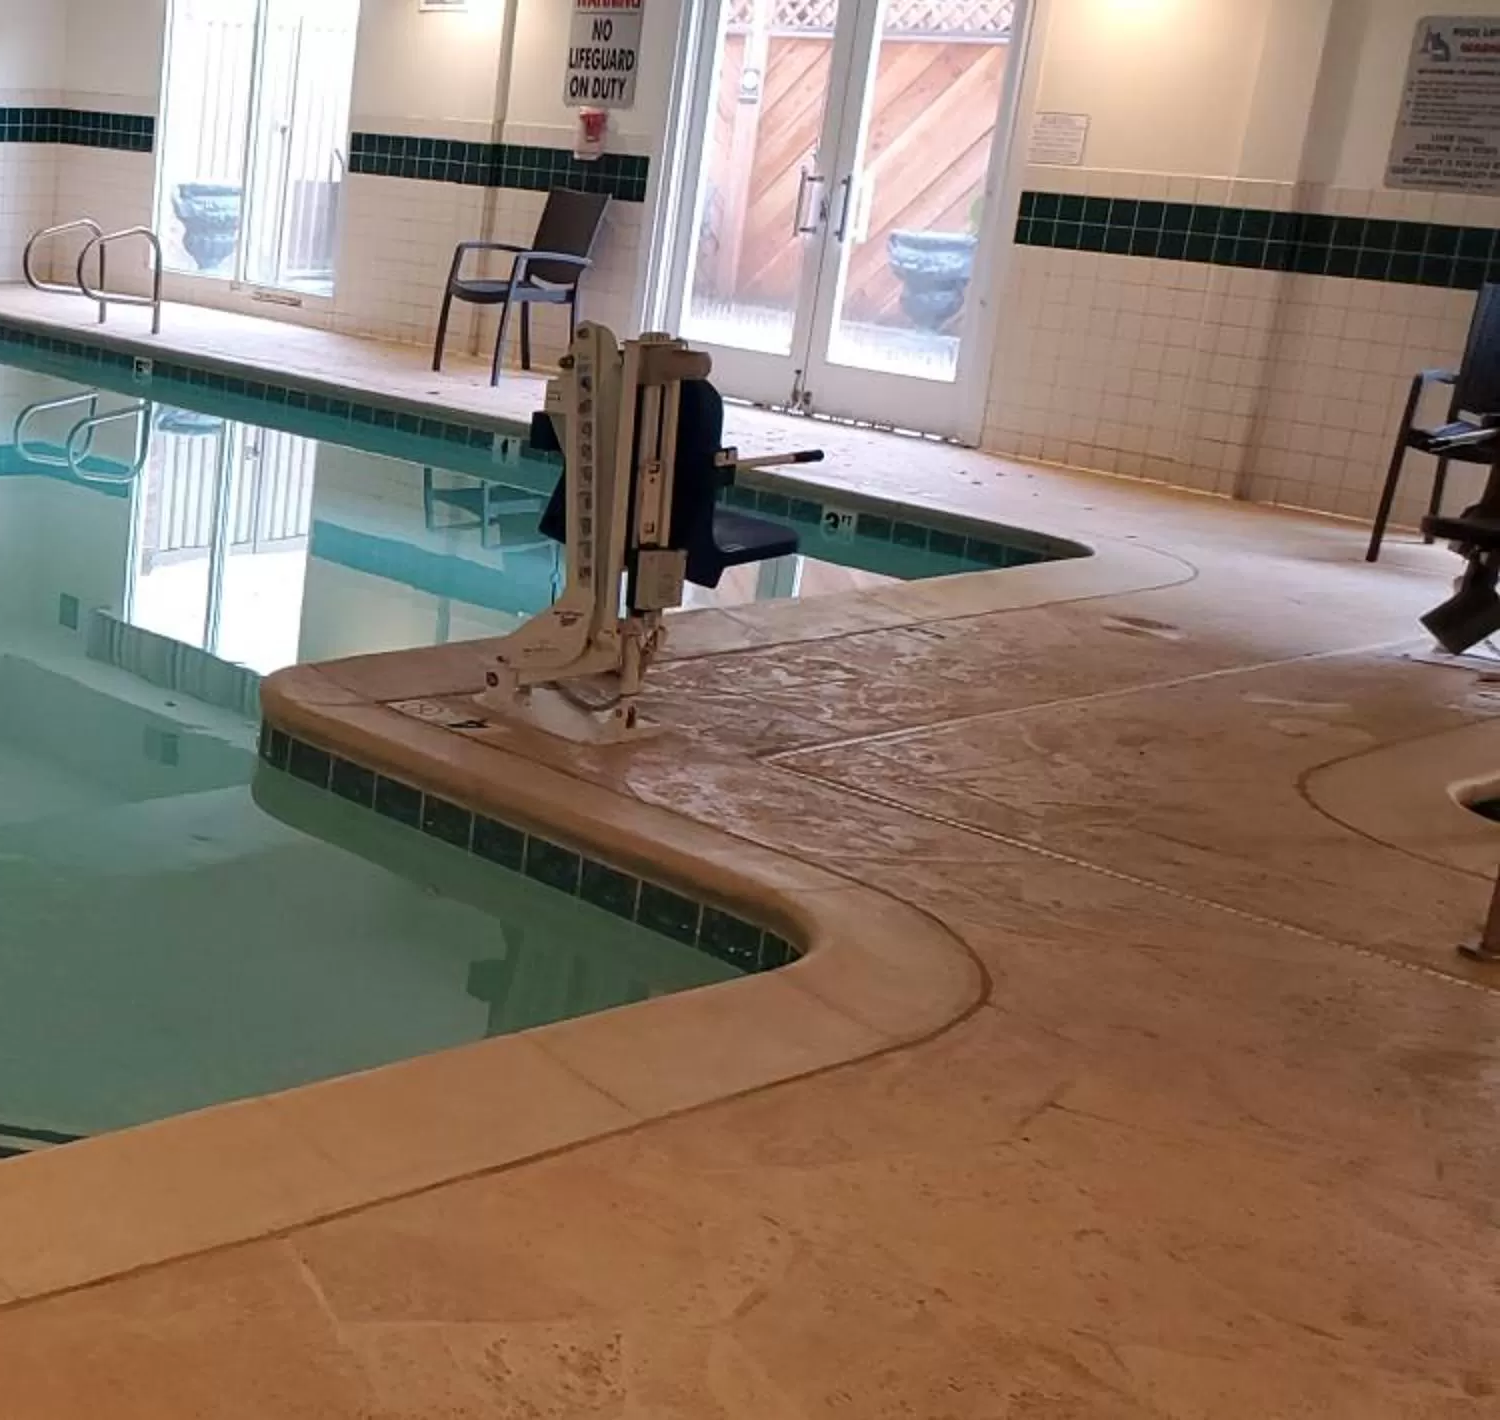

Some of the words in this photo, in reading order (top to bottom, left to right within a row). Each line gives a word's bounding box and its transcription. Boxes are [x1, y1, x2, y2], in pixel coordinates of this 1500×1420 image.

[591, 18, 613, 41] NO
[568, 48, 635, 71] LIFEGUARD
[569, 76, 588, 98] ON
[591, 77, 627, 99] DUTY
